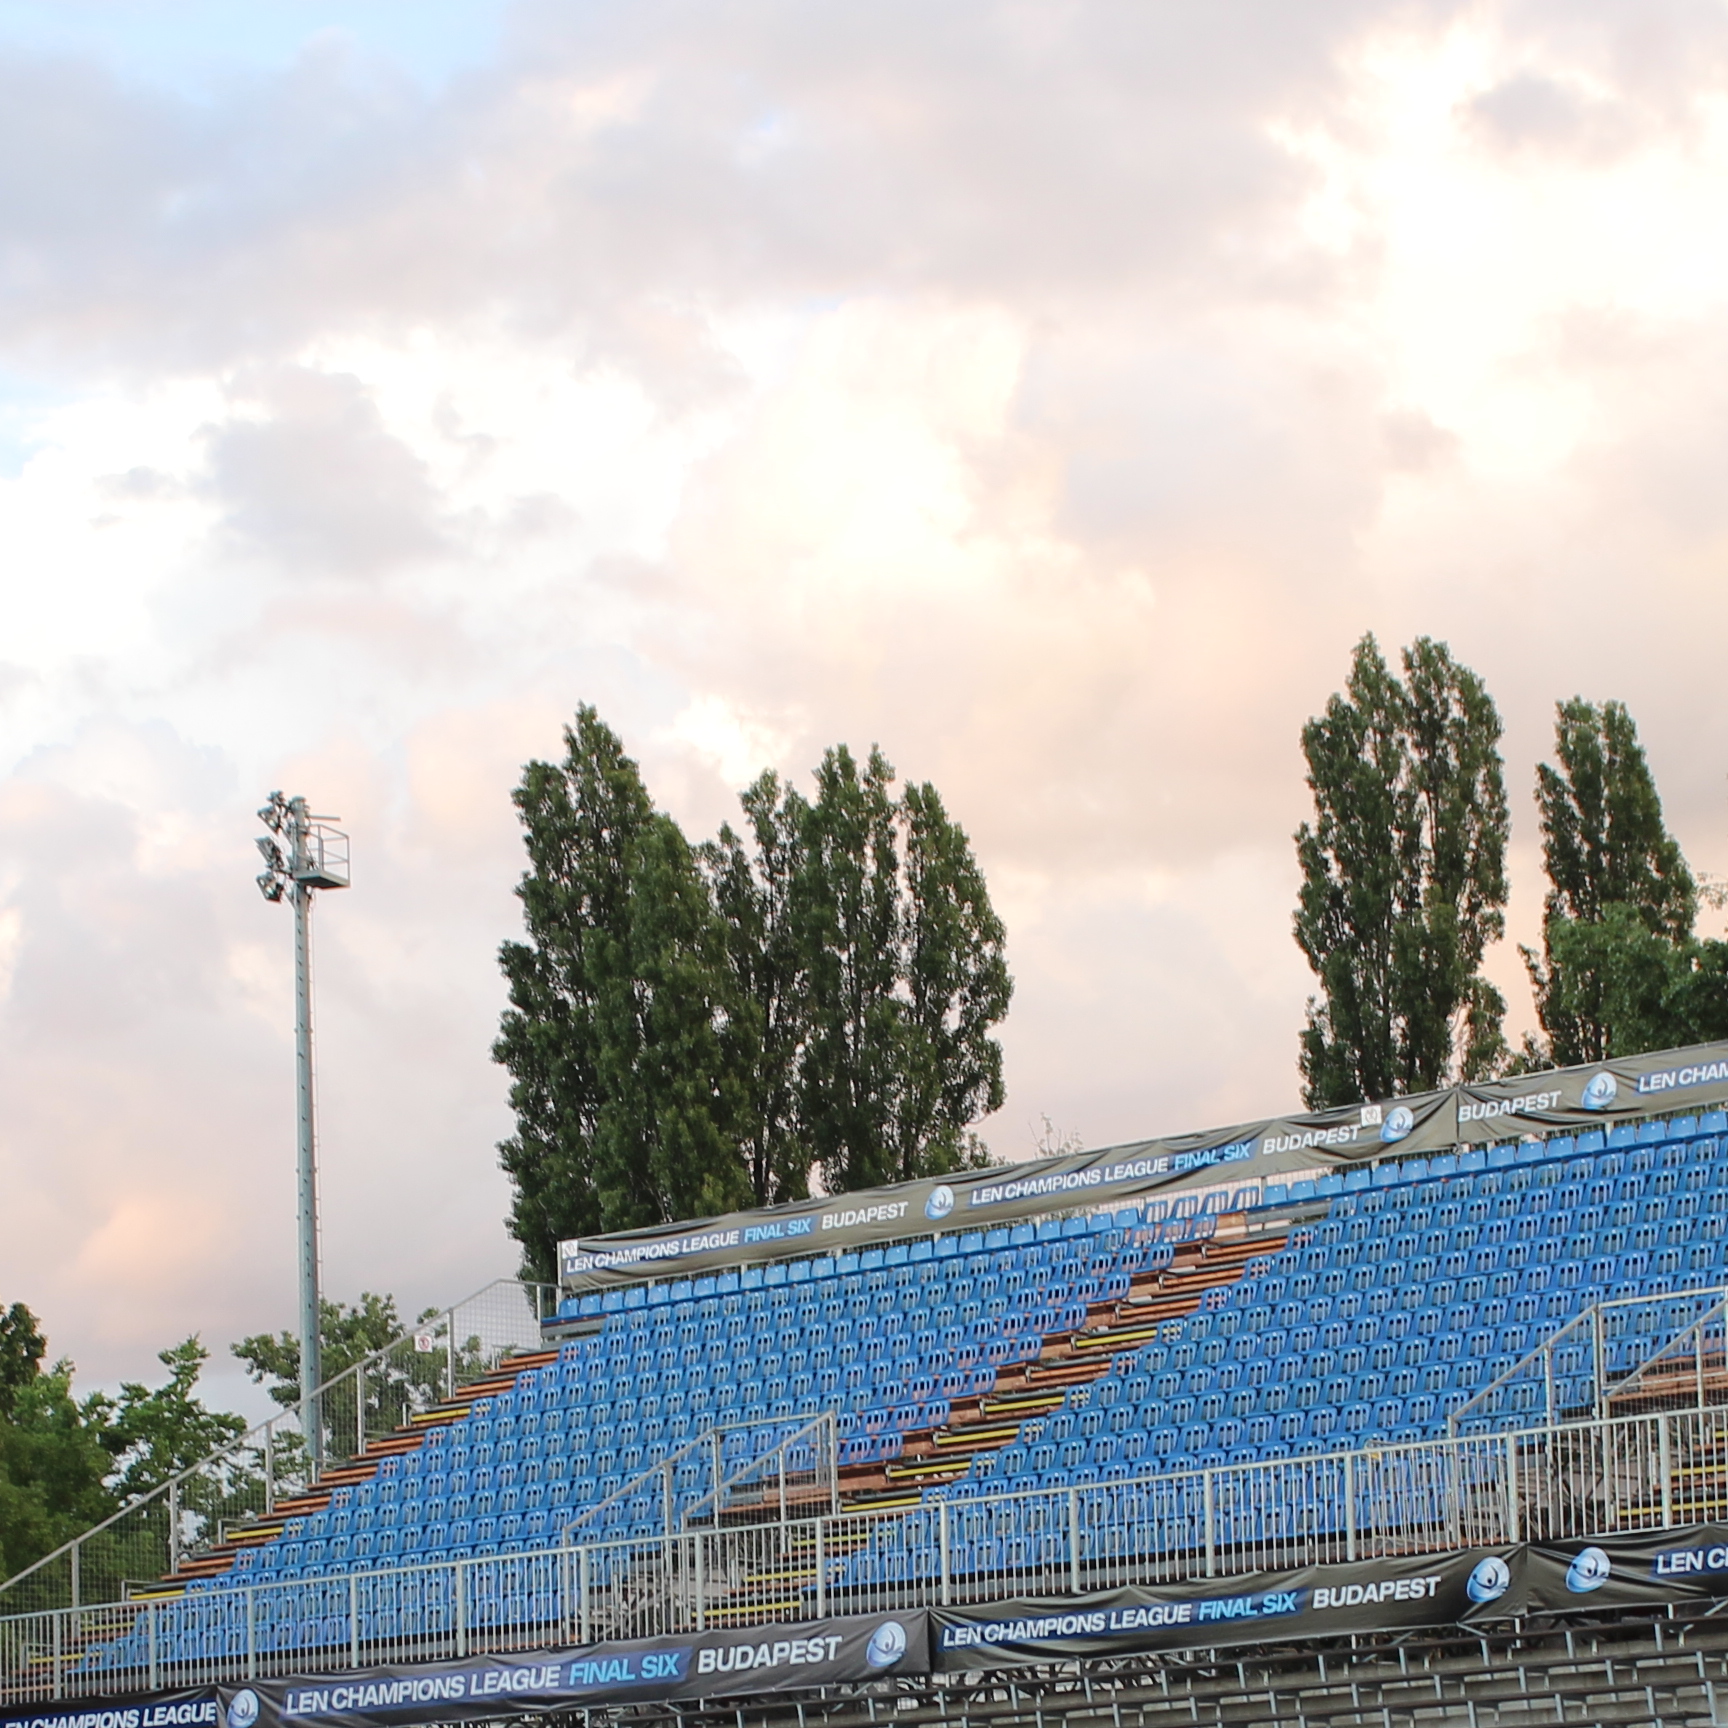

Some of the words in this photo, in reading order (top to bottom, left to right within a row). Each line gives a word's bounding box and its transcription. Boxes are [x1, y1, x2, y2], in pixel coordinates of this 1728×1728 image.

[1457, 1089, 1562, 1124] BUDAPEST
[1639, 1069, 1675, 1093] LEN
[972, 1185, 1003, 1205] LEN
[1004, 1169, 1102, 1200] CHAMPIONS
[1104, 1156, 1169, 1182] LEAGUE
[1174, 1147, 1221, 1172] FINAL
[1222, 1141, 1251, 1163] SIX
[1262, 1123, 1361, 1156] BUDAPEST
[566, 1253, 593, 1273] LEN
[594, 1242, 680, 1270] CHAMPIONS
[682, 1230, 740, 1254] LEAGUE
[744, 1221, 785, 1244] FINAL
[786, 1217, 812, 1237] SIX
[821, 1201, 909, 1231] BUDAPEST
[1656, 1548, 1705, 1575] LEN
[943, 1624, 983, 1649] LEN
[984, 1612, 1106, 1643] CHAMPIONS
[1109, 1603, 1191, 1631] LEAGUE
[1198, 1596, 1258, 1622] FINAL
[1261, 1592, 1297, 1616] SIX
[1312, 1575, 1442, 1611] BUDAPEST
[286, 1688, 330, 1714] LEN
[332, 1675, 466, 1711] CHAMPIONS
[469, 1666, 560, 1696] LEAGUE
[569, 1657, 635, 1687] FINAL
[640, 1652, 679, 1679] SIX
[696, 1635, 843, 1675] BUDAPEST
[142, 1701, 216, 1728] LEAGUE
